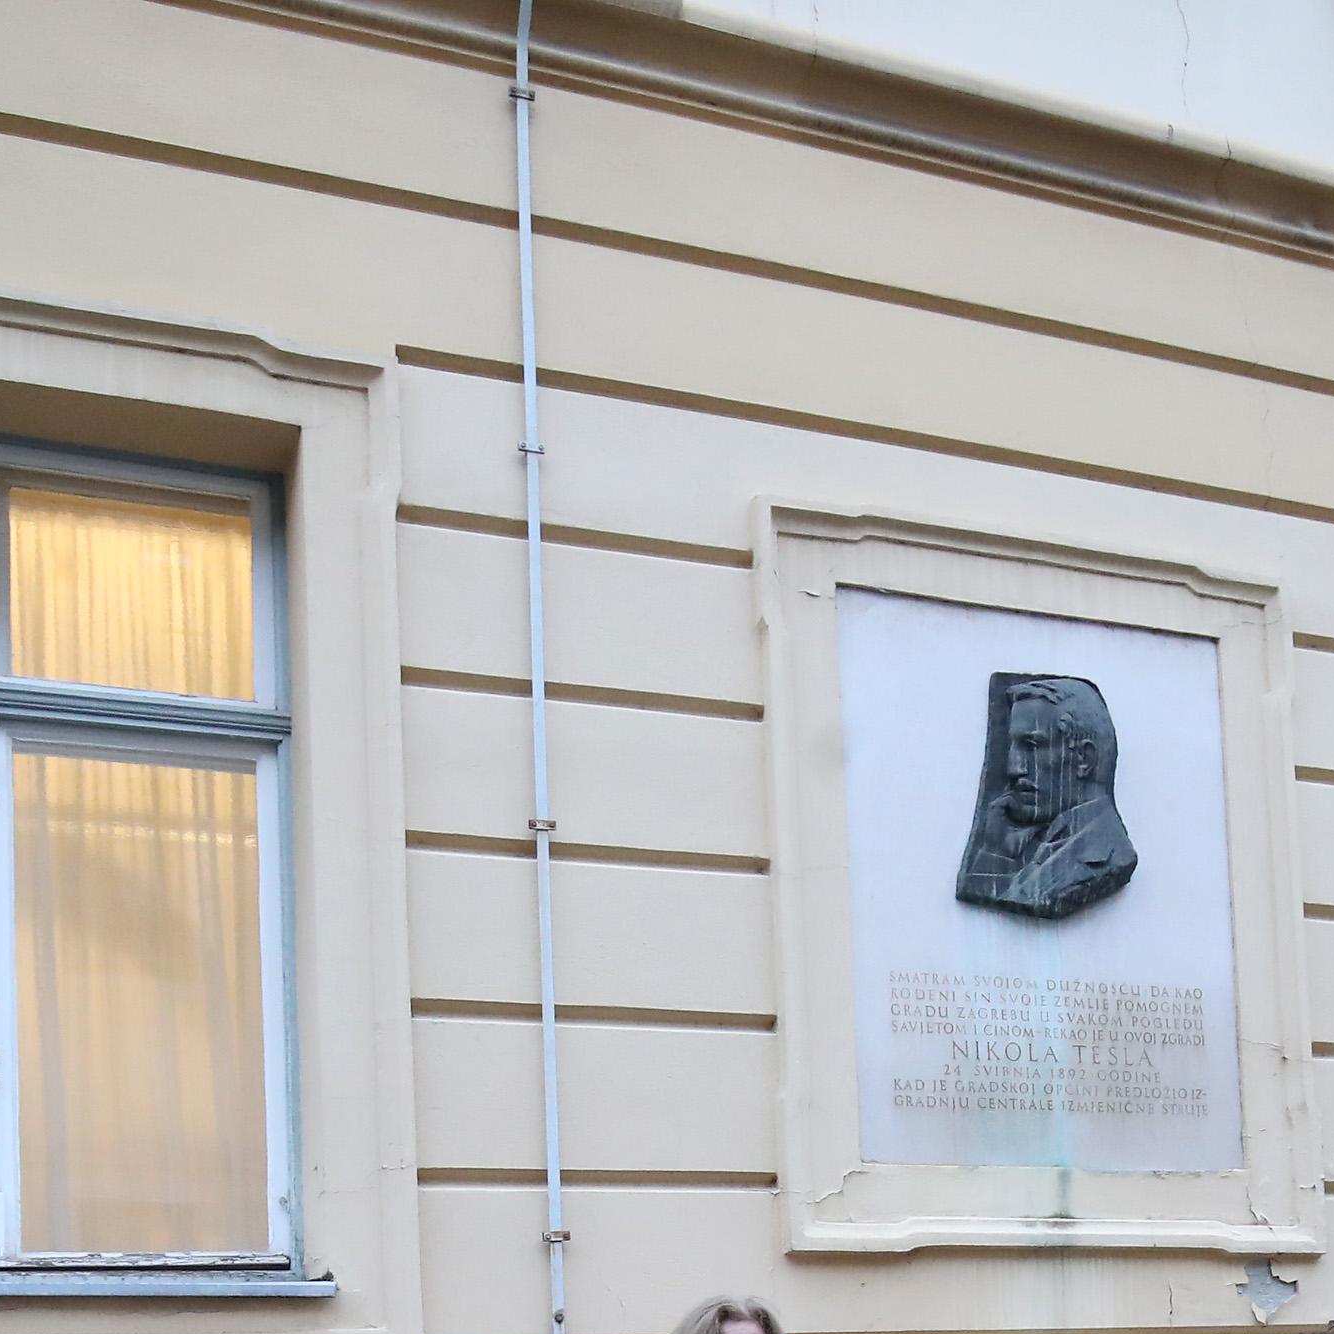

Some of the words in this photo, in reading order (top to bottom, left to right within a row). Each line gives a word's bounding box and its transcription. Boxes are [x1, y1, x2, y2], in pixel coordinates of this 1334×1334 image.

[1175, 987, 1203, 1000] KAO
[1117, 999, 1203, 1015] POMOGNEM
[891, 1003, 948, 1018] GRADU
[957, 1006, 1030, 1022] ZAGREBU
[1040, 1011, 1050, 1022] U
[1058, 1013, 1123, 1028] SVAKOM
[1132, 1016, 1203, 1031] POGLEDU
[1092, 1030, 1104, 1043] JE
[1109, 1030, 1118, 1042] U
[952, 1040, 1059, 1063] NIKOLA
[1072, 1045, 1154, 1068] TESLA
[1050, 1068, 1087, 1081] 1892
[1097, 1070, 1162, 1083] GODINE
[893, 1078, 925, 1092] KAD
[933, 1079, 947, 1093] JE
[954, 1080, 1036, 1096] GRADSKOJ
[894, 1095, 969, 1112] GRADNJU
[977, 1097, 1054, 1112] CENTRALE
